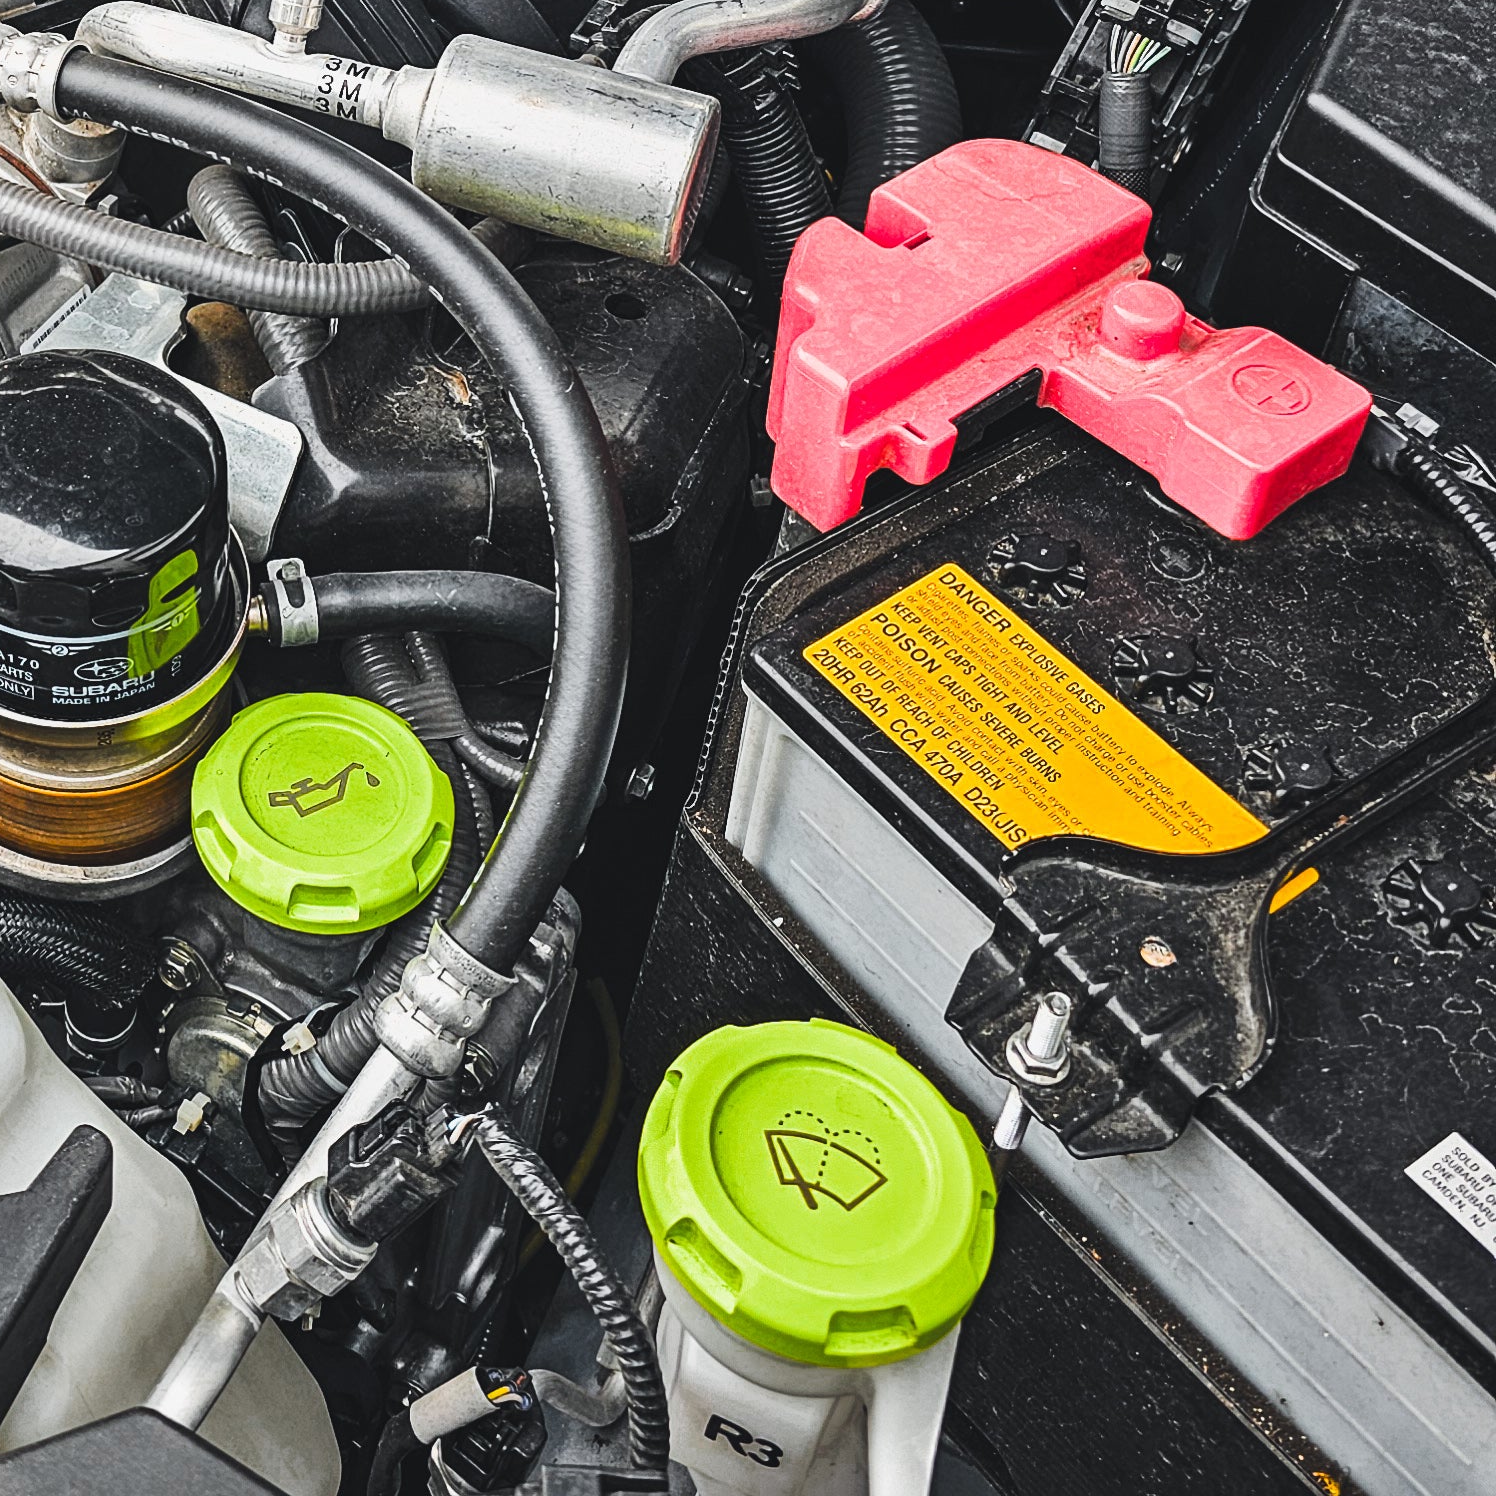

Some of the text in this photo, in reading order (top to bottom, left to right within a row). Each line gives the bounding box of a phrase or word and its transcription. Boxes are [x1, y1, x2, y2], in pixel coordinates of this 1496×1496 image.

[316, 74, 362, 102] 3M
[52, 670, 155, 696] SUBARU
[114, 682, 155, 700] JAPAN
[868, 613, 1063, 782] POISON CAUSES SEVERE BURNS
[890, 602, 1067, 753] KEEP VENT CAPS TIGHT AND LEVEL
[915, 604, 943, 625] adjust
[941, 627, 962, 642] post
[960, 644, 1013, 686] connections
[1009, 687, 1046, 715] without
[1043, 717, 1075, 741] proper
[1073, 743, 1127, 785] instruction
[1123, 787, 1145, 802] and
[915, 589, 942, 610] shield
[938, 611, 962, 629] eyes
[961, 629, 980, 642] and
[978, 644, 999, 659] face
[998, 661, 1021, 678] from
[1054, 710, 1069, 720] Do
[1068, 721, 1085, 734] not
[1082, 735, 1117, 762] charge
[1126, 774, 1144, 787] use
[1143, 789, 1182, 819] booster
[938, 572, 1106, 713] DANGER EXPLOSIVE GASES
[811, 648, 855, 690] 20HR
[850, 683, 889, 718] 62Ah
[889, 718, 927, 755] CCA
[922, 749, 964, 787] 470A
[831, 638, 1007, 789] KEEP OUT OF REACH OF CHILDREN
[847, 631, 859, 639] of
[856, 640, 895, 670] accident
[892, 671, 917, 690] flush
[913, 691, 938, 710] with
[934, 711, 963, 732] water
[961, 735, 981, 749] and
[979, 751, 998, 764] call
[1001, 773, 1051, 811] physician
[856, 624, 895, 655] Contains
[890, 655, 928, 684] sulfuric
[944, 704, 974, 726] Avoid
[970, 727, 1007, 755] contact
[1003, 757, 1028, 775] with
[1046, 797, 1072, 816] eyes
[1069, 818, 1082, 826] or
[971, 622, 1002, 646] flames
[1009, 657, 1041, 681] sparks
[1039, 682, 1066, 702] could
[1064, 703, 1091, 724] cause
[1089, 725, 1127, 754] battery
[1125, 756, 1138, 764] to
[1174, 800, 1215, 832] Always
[1432, 1162, 1496, 1221] ONE SUBARU
[1442, 1155, 1484, 1191] SUBARU
[1451, 1146, 1481, 1172] SOLD
[704, 1415, 785, 1469] R3
